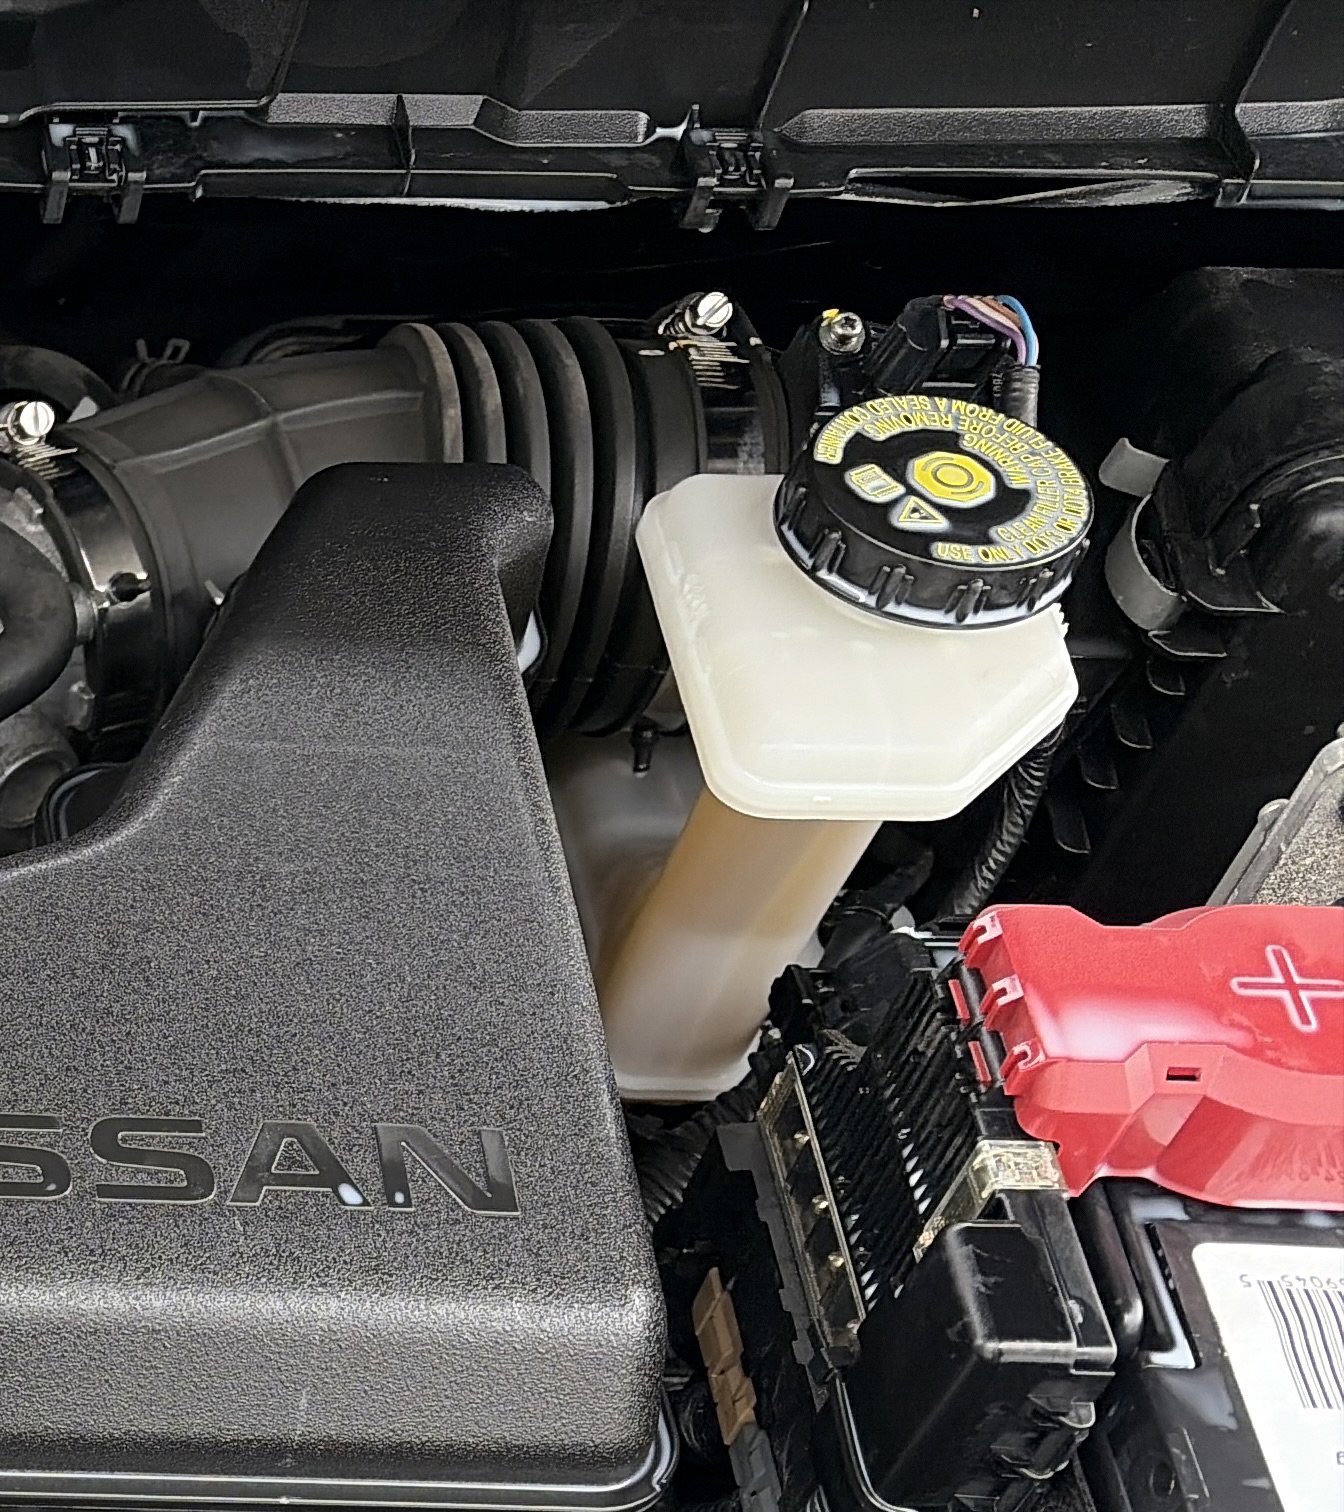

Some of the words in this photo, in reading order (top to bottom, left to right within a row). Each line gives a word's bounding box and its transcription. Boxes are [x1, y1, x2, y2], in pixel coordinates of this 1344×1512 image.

[865, 395, 929, 416] SEALED
[934, 396, 949, 412] A
[951, 399, 1005, 426] FROM
[816, 405, 871, 461] CONTAINER
[864, 412, 953, 439] REMOVING
[958, 415, 1029, 454] BEFORE
[1003, 418, 1053, 450] FLUID
[962, 433, 1032, 486] WARNING
[1020, 454, 1053, 477] CAP
[1041, 447, 1086, 486] BRAKE
[1033, 480, 1060, 517] FILLER
[1063, 488, 1088, 518] DOT4
[997, 515, 1048, 542] CLEAN
[1052, 516, 1080, 535] OR
[937, 543, 972, 560] USE
[977, 544, 1026, 563] ONLY
[1023, 529, 1066, 554] DOT3
